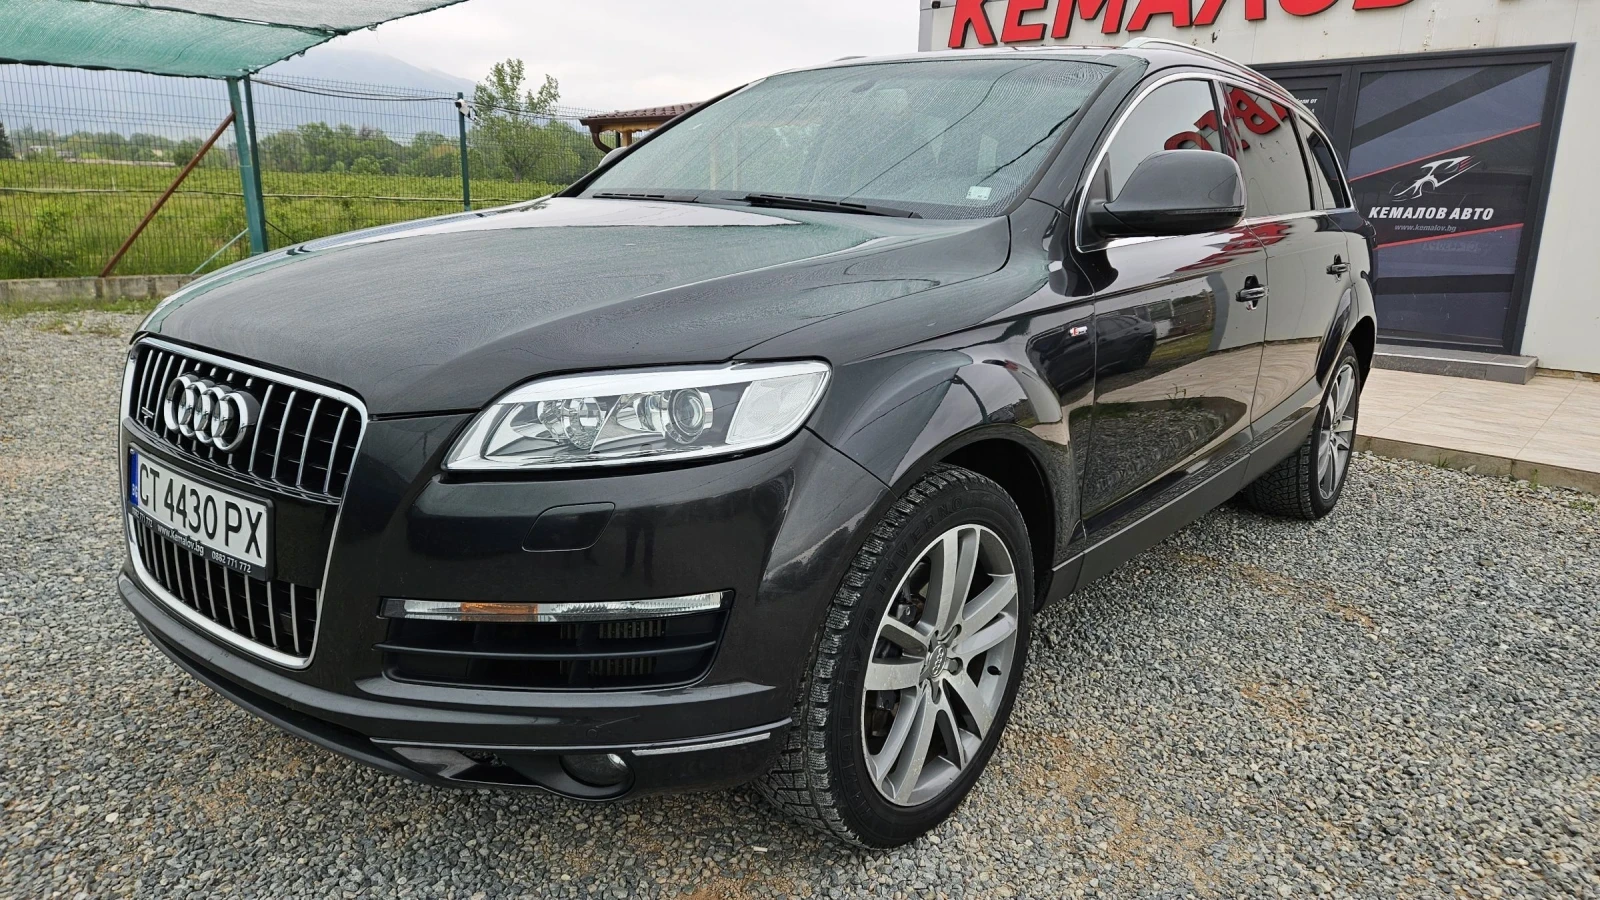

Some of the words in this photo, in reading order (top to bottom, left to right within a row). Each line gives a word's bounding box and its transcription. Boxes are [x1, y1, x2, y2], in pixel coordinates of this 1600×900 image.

[1368, 206, 1447, 219] КЕМАЛОВ
[1448, 207, 1494, 220] АВТО
[1394, 224, 1457, 232] www.kemalov.bg
[139, 462, 160, 513] CT
[163, 477, 218, 540] 4430
[224, 500, 263, 559] PX
[157, 523, 205, 556] www.Kemalov.bg
[875, 497, 963, 596] INVERNO
[226, 556, 238, 568] 771
[239, 561, 251, 573] 772
